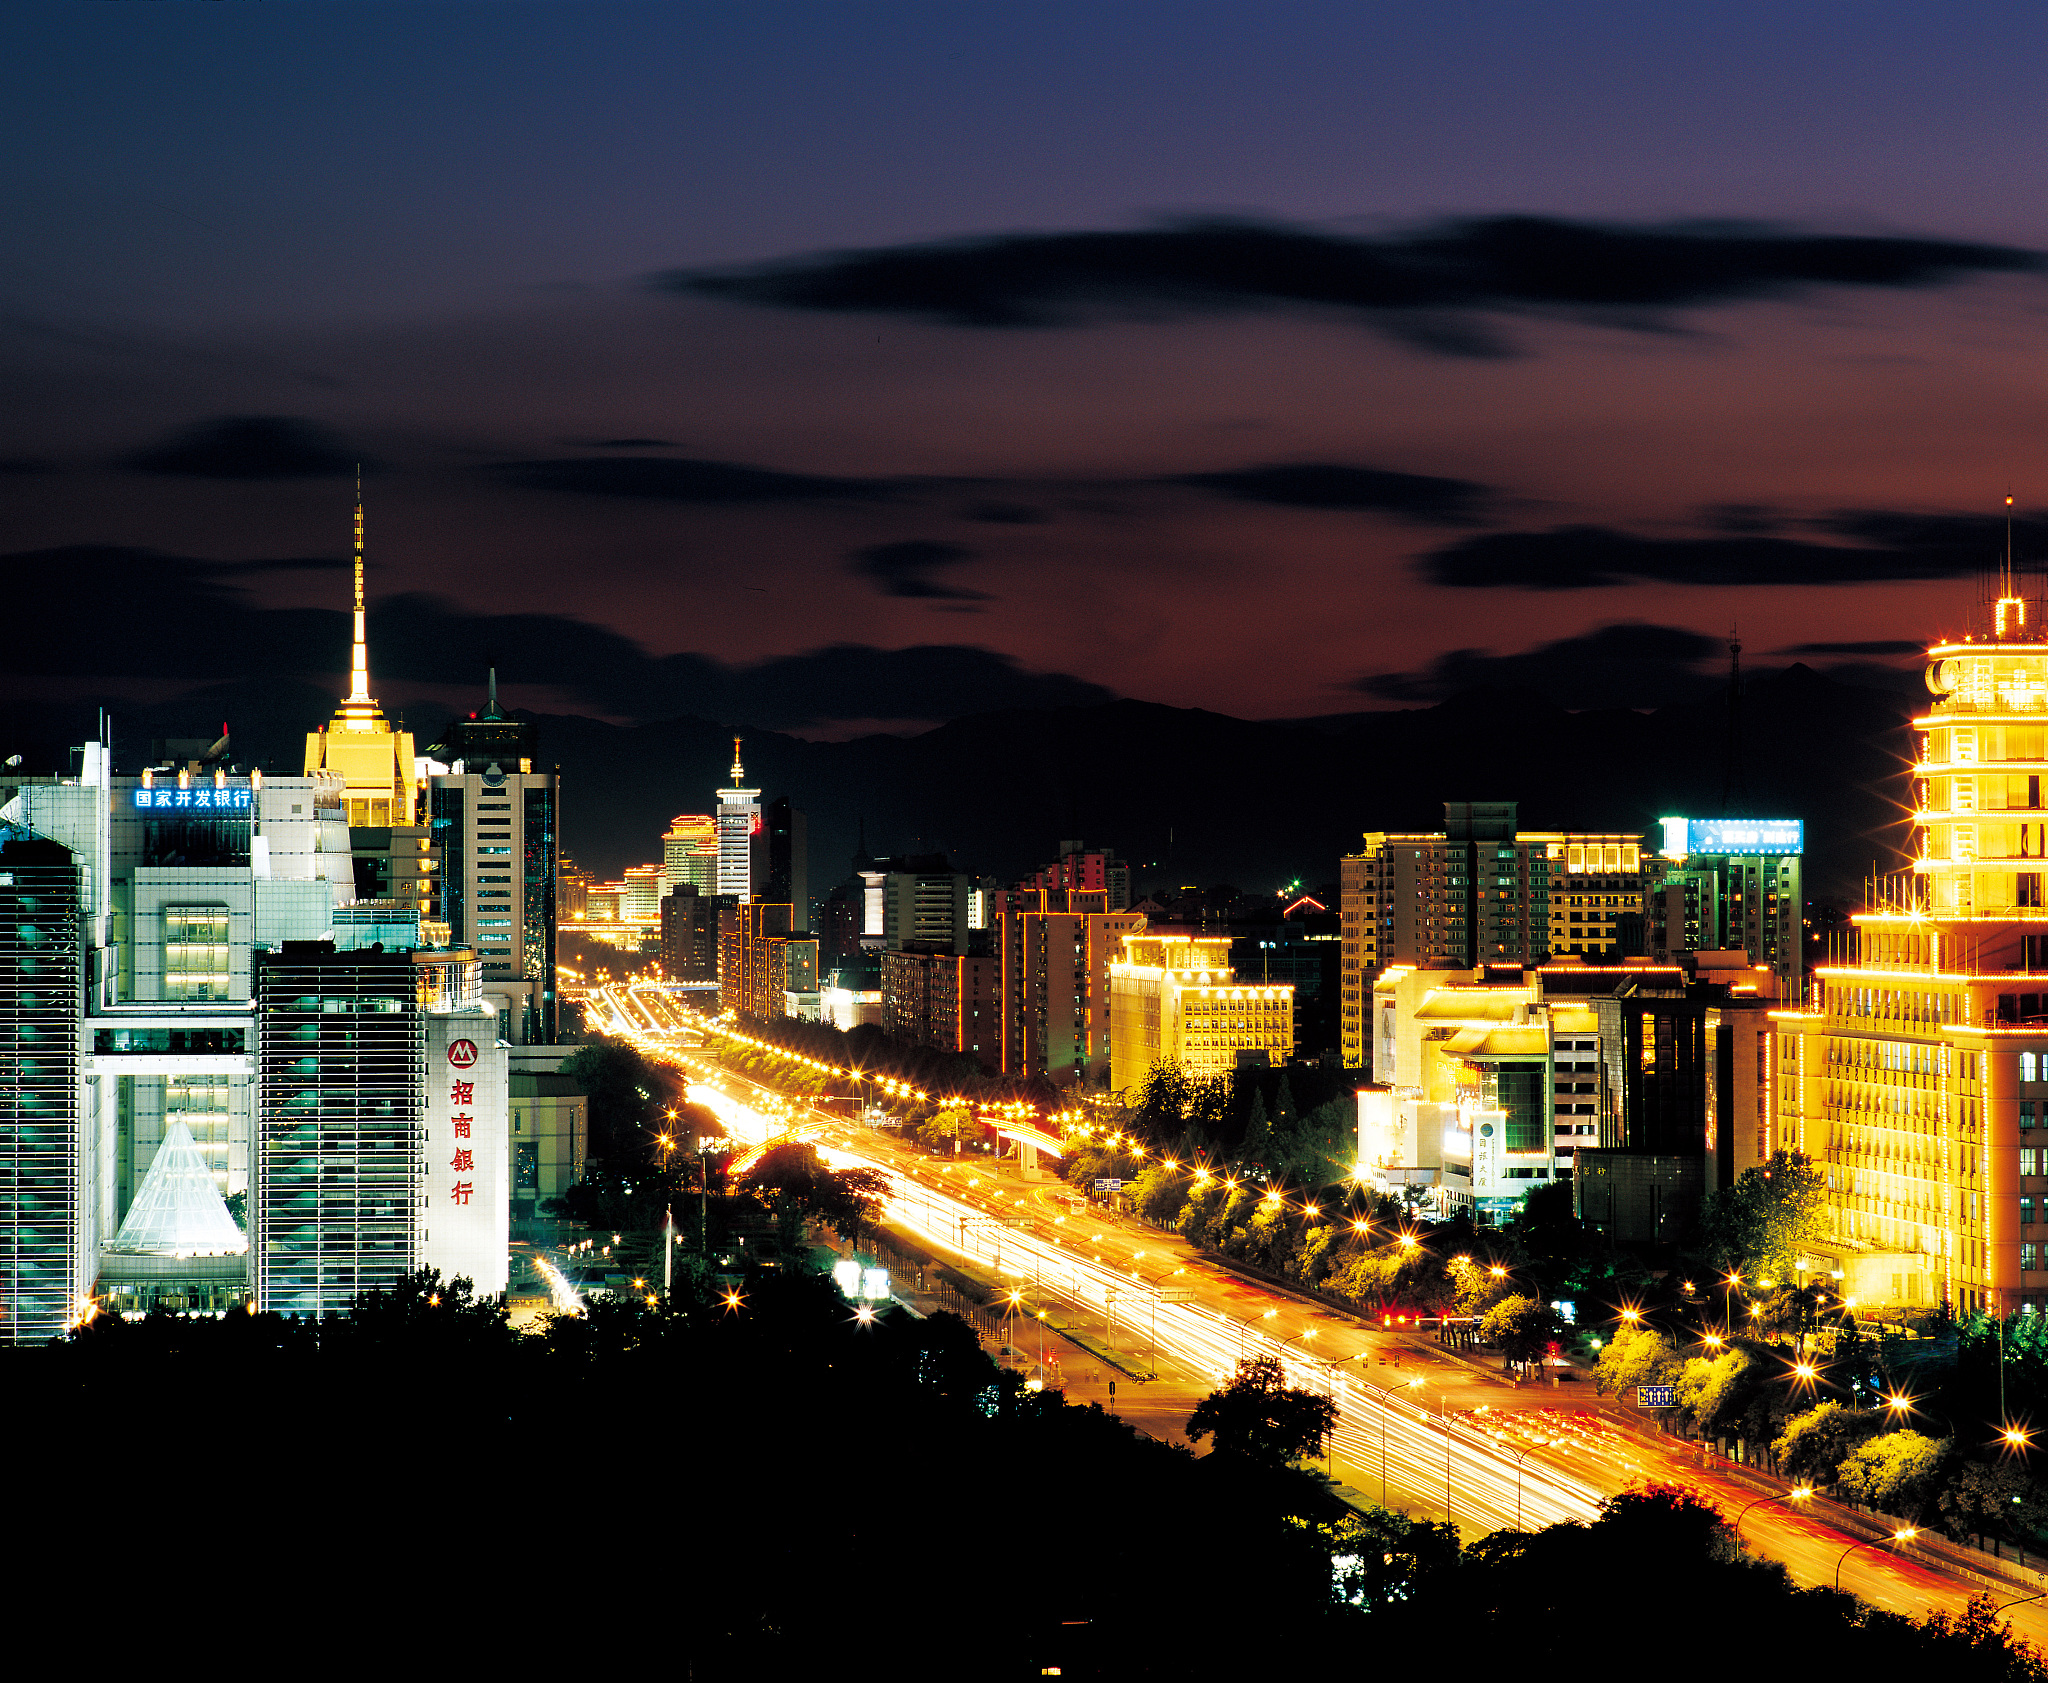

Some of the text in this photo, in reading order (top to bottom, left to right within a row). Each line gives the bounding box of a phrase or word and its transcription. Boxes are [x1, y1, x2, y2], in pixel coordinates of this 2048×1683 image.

[136, 789, 250, 807] 国家开发银行
